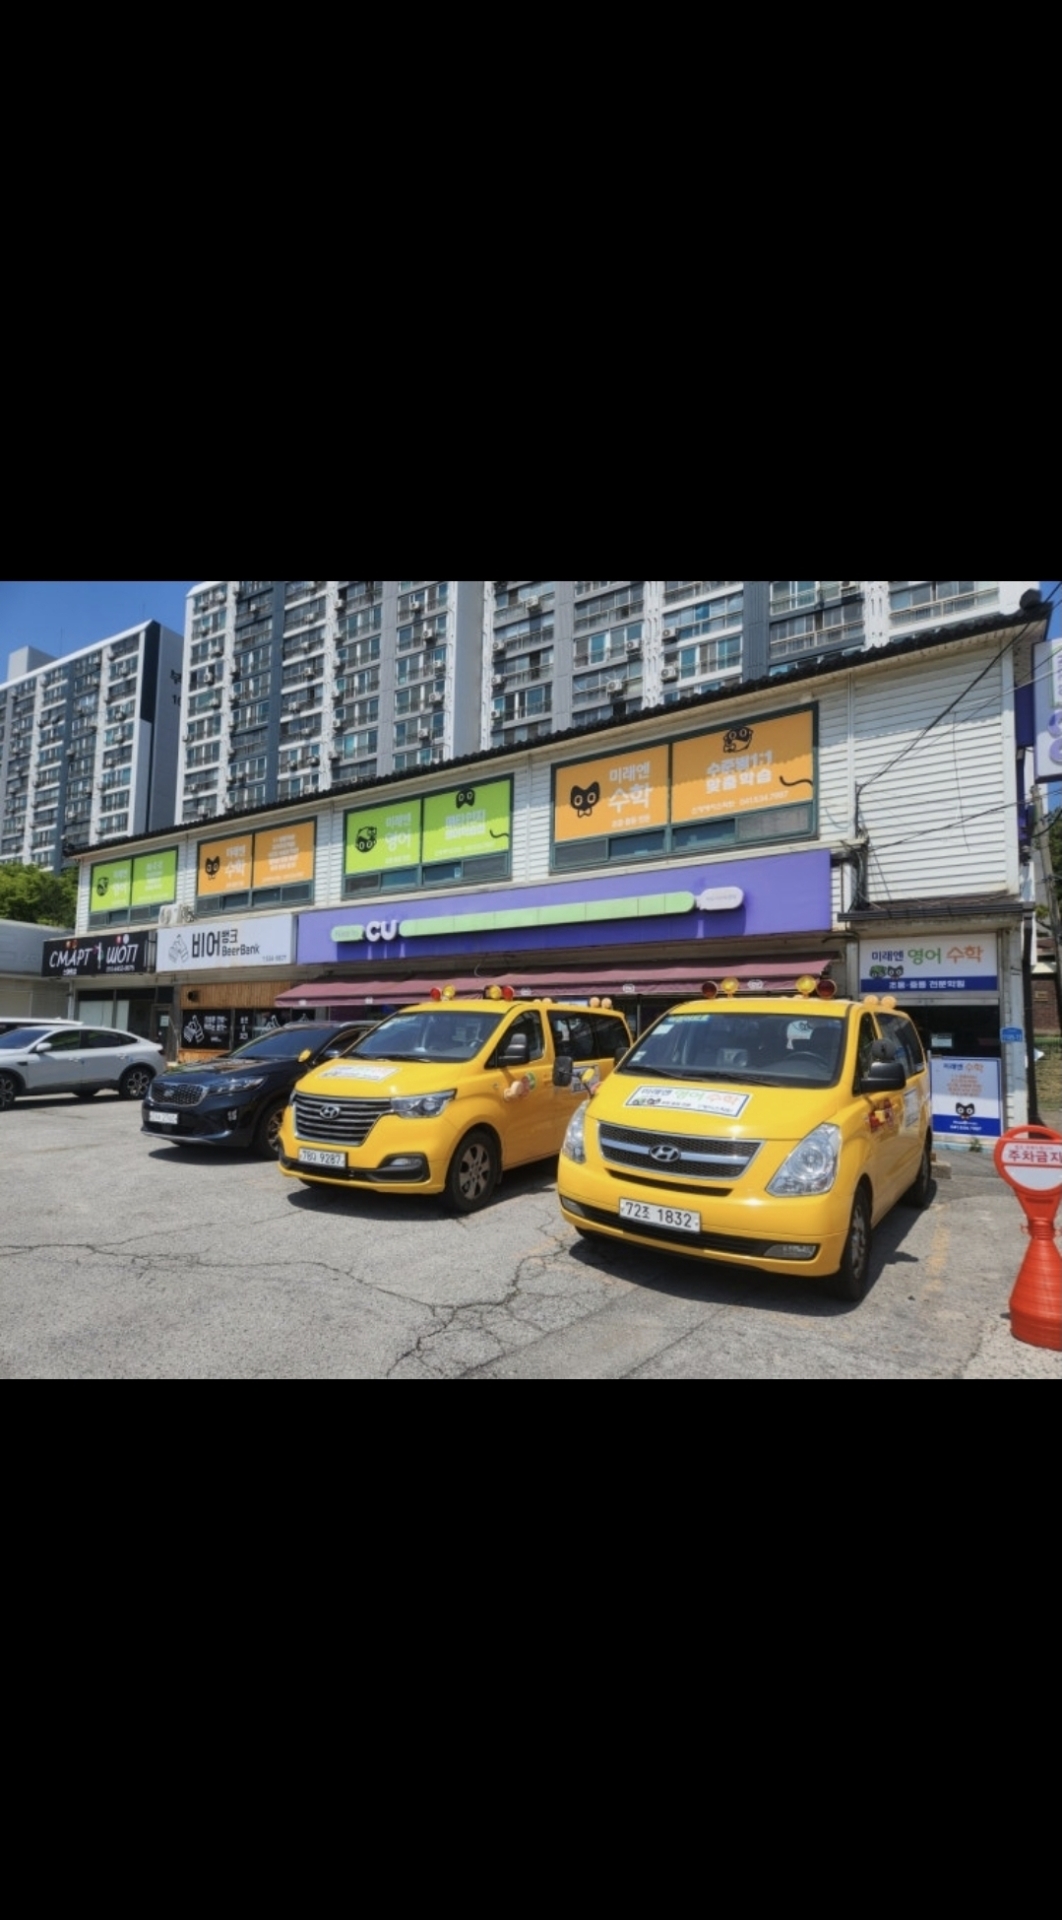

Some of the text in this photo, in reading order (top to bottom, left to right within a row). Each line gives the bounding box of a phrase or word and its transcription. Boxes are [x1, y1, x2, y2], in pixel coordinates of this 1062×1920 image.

[609, 760, 650, 784] 미래엔
[608, 782, 653, 814] 수학
[366, 919, 398, 942] CU
[192, 931, 220, 958] 비어
[222, 943, 260, 957] BeerBank
[871, 946, 984, 964] 미래엔 영어 수학
[319, 1152, 341, 1165] 9287
[625, 1201, 692, 1229] 72조 1832
